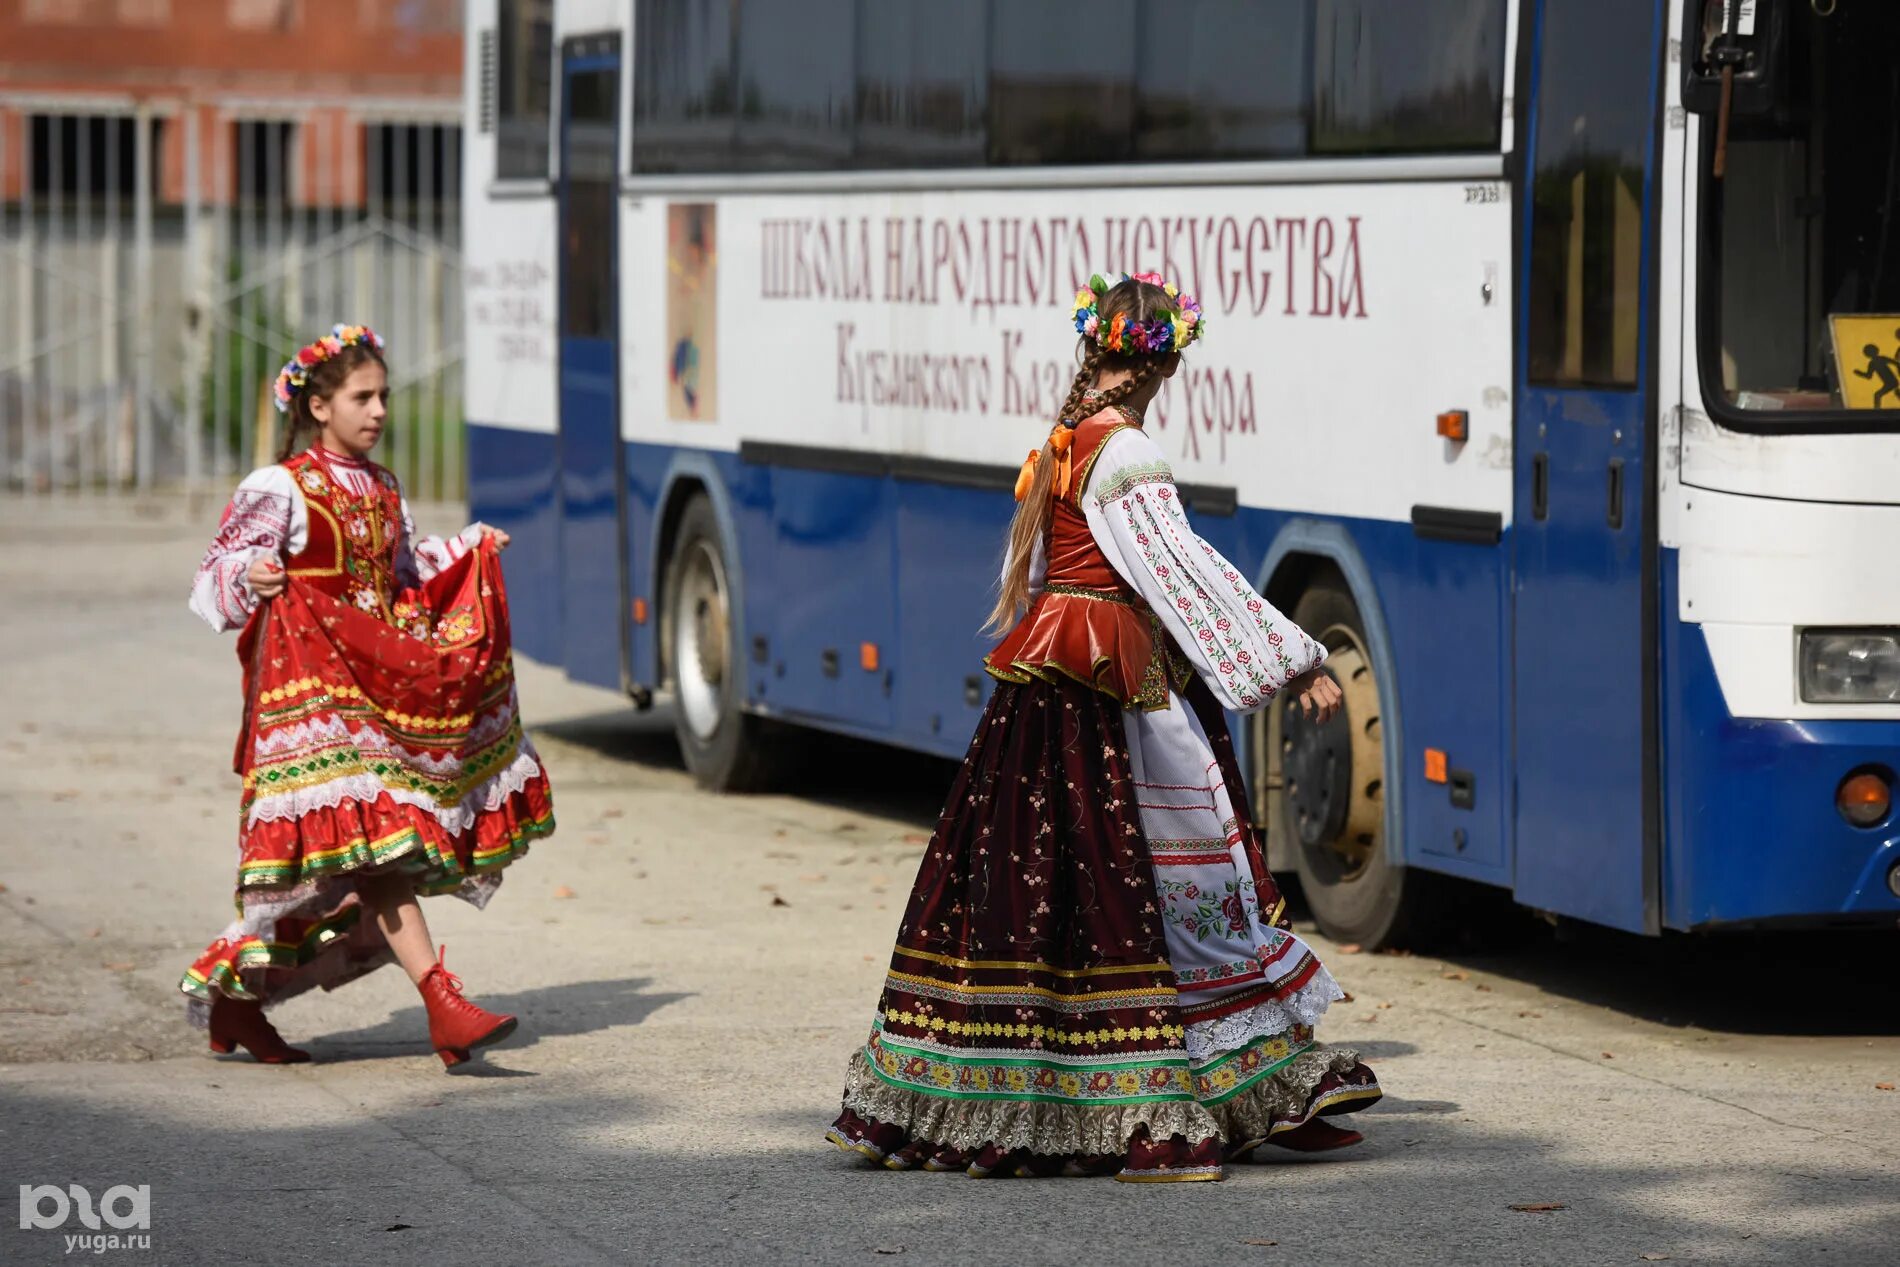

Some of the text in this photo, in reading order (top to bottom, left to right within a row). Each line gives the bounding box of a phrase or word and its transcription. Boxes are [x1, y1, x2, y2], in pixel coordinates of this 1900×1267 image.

[761, 216, 1369, 327] ШКОЛА НАРОДНОГО ИСКУССТВА
